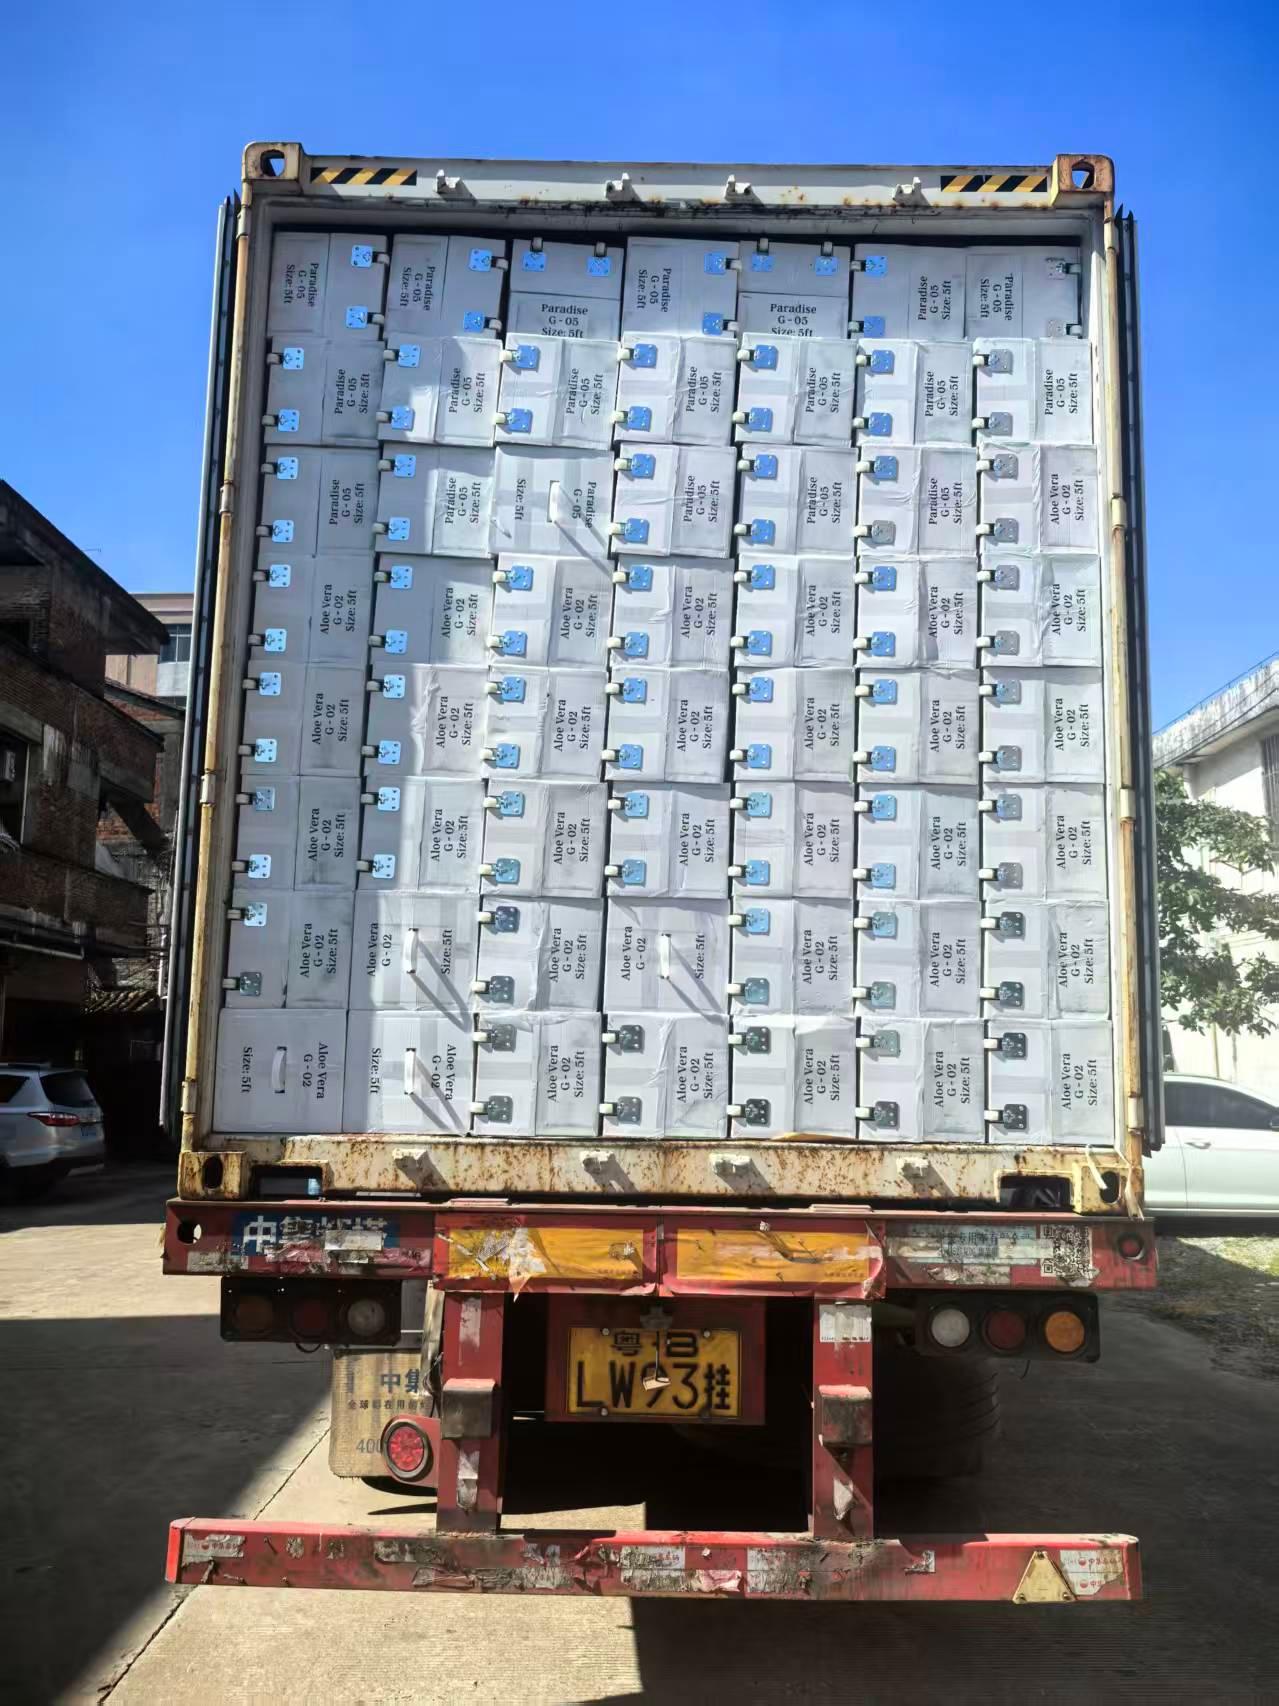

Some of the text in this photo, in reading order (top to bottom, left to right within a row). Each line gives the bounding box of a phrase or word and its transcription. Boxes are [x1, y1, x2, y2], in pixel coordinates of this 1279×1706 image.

[307, 262, 320, 307] Paradise
[423, 266, 436, 311] Paradise
[541, 303, 589, 315] Paradise
[660, 268, 672, 313] Paradise
[770, 303, 817, 314] Paradise
[917, 275, 928, 321] Paradise
[1004, 273, 1014, 321] Paradise
[334, 368, 346, 415] Paradise
[448, 368, 461, 414] Paradise
[565, 368, 579, 414] Paradise
[685, 366, 698, 412] Paradise
[805, 367, 817, 413] Paradise
[924, 371, 934, 417] Paradise
[1044, 369, 1054, 415] Paradise
[328, 479, 340, 525] Paradise
[444, 477, 457, 524] Paradise
[584, 481, 597, 533] Paradise
[681, 475, 696, 522] Paradise
[805, 476, 818, 524] Paradise
[928, 478, 938, 525] Paradise
[1049, 473, 1060, 525] Aloe Vera
[320, 584, 333, 635] Aloe Vera
[441, 587, 454, 639] Aloe Vera
[560, 587, 573, 639] Aloe Vera
[680, 586, 693, 639] Aloe Vera
[806, 585, 817, 637] Aloe Vera
[928, 586, 938, 638] Aloe Vera
[1051, 583, 1061, 636] Aloe Vera
[311, 693, 324, 745] Aloe Vera
[435, 696, 448, 749] Aloe Vera
[553, 699, 566, 752] Aloe Vera
[676, 699, 689, 752] Aloe Vera
[804, 697, 815, 751] Aloe Vera
[929, 699, 940, 753] Aloe Vera
[1054, 698, 1064, 751] Aloe Vera
[307, 808, 320, 861] Aloe Vera
[430, 809, 443, 862] Aloe Vera
[553, 812, 566, 865] Aloe Vera
[679, 813, 690, 866] Aloe Vera
[803, 812, 814, 866] Aloe Vera
[930, 816, 941, 870] Aloe Vera
[1055, 815, 1066, 869] Aloe Vera
[299, 923, 313, 978] Aloe Vera
[366, 922, 379, 977] Aloe Vera
[548, 927, 562, 983] Aloe Vera
[621, 926, 633, 981] Aloe Vera
[802, 929, 812, 985] Aloe Vera
[929, 932, 940, 987] Aloe Vera
[1058, 932, 1068, 988] Aloe Vera
[316, 1042, 329, 1099] Aloe Vera
[445, 1043, 457, 1101] Aloe Vera
[547, 1045, 559, 1102] Aloe Vera
[676, 1046, 688, 1103] Aloe Vera
[803, 1048, 814, 1105] Aloe Vera
[933, 1051, 944, 1108] Aloe Vera
[1061, 1053, 1071, 1110] Aloe Vera
